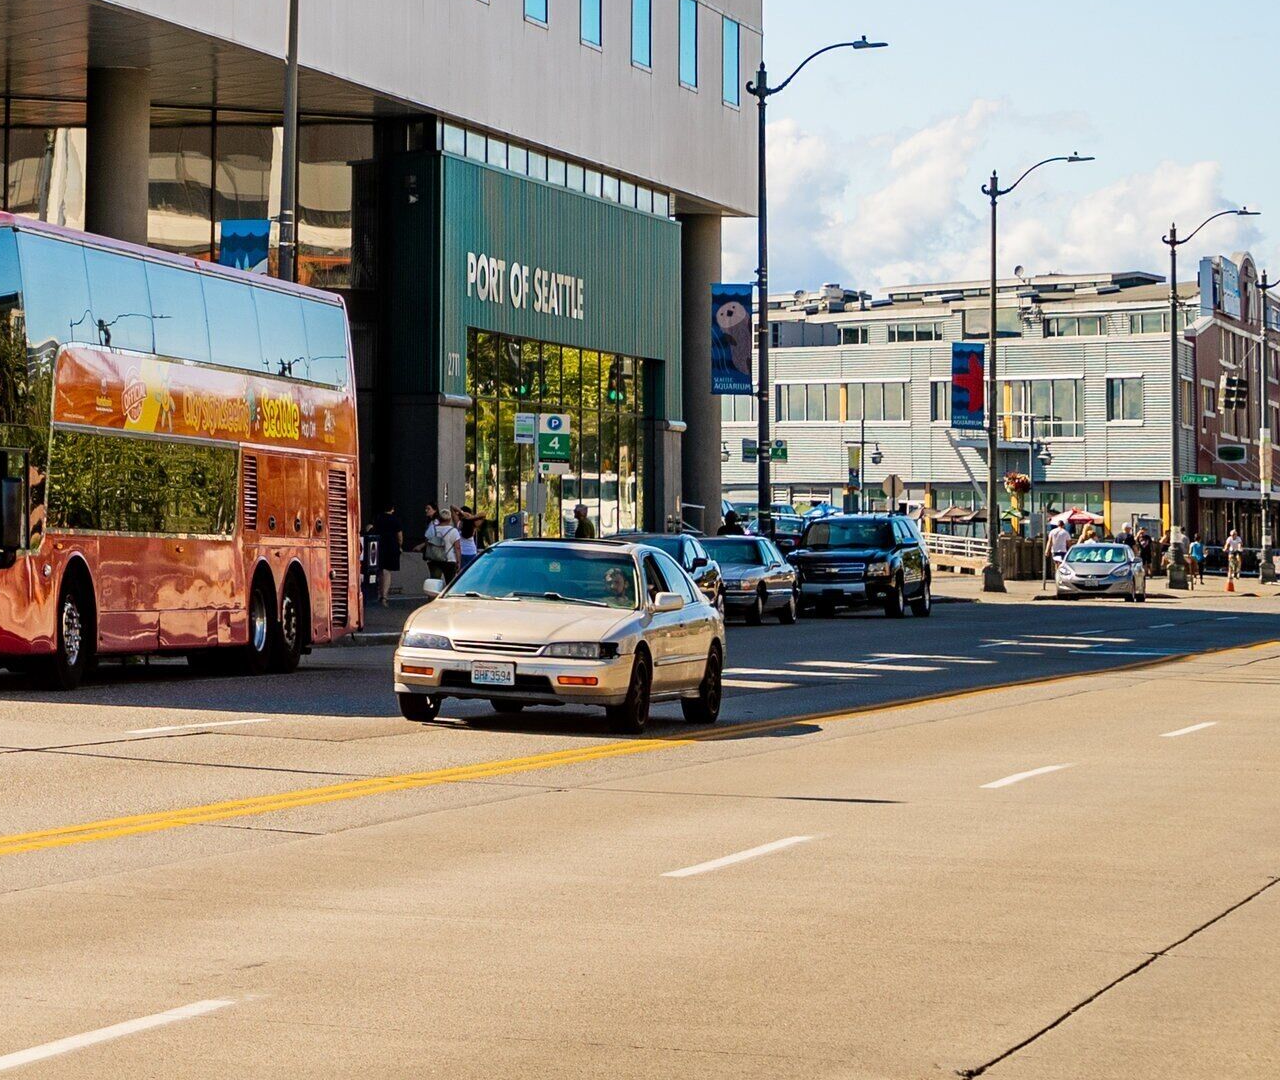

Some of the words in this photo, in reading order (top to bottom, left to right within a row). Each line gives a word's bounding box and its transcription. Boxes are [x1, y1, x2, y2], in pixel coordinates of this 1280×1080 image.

[467, 251, 506, 304] PORT
[510, 262, 529, 310] OF
[533, 266, 584, 320] SEATTLE
[124, 382, 146, 410] OFFICIAL
[260, 387, 300, 440] Seattle
[552, 419, 559, 428] P
[548, 436, 560, 450] 4
